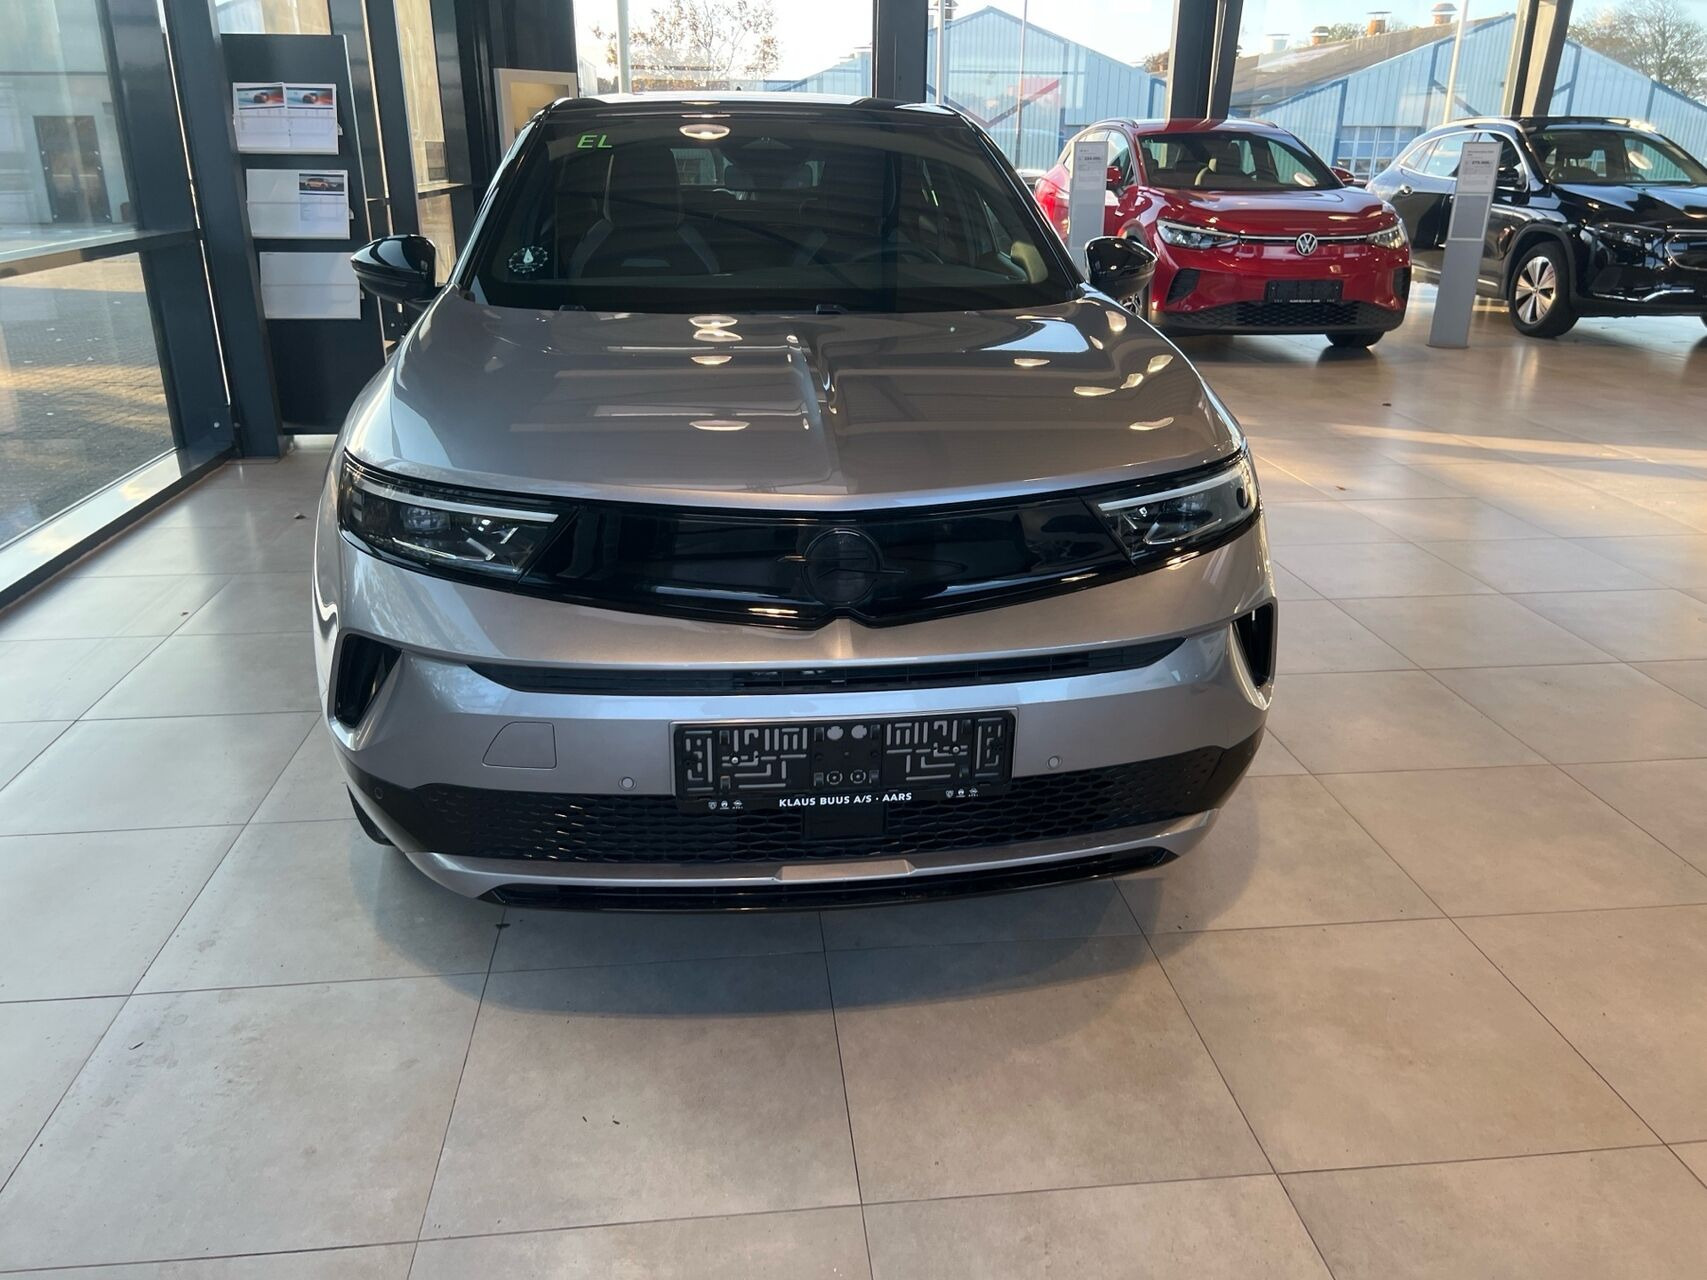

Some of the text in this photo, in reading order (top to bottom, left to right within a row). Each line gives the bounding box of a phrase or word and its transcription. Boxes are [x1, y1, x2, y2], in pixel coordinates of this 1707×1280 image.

[577, 134, 614, 149] EL
[779, 792, 912, 807] KLAUS BUUS A/S AARS
